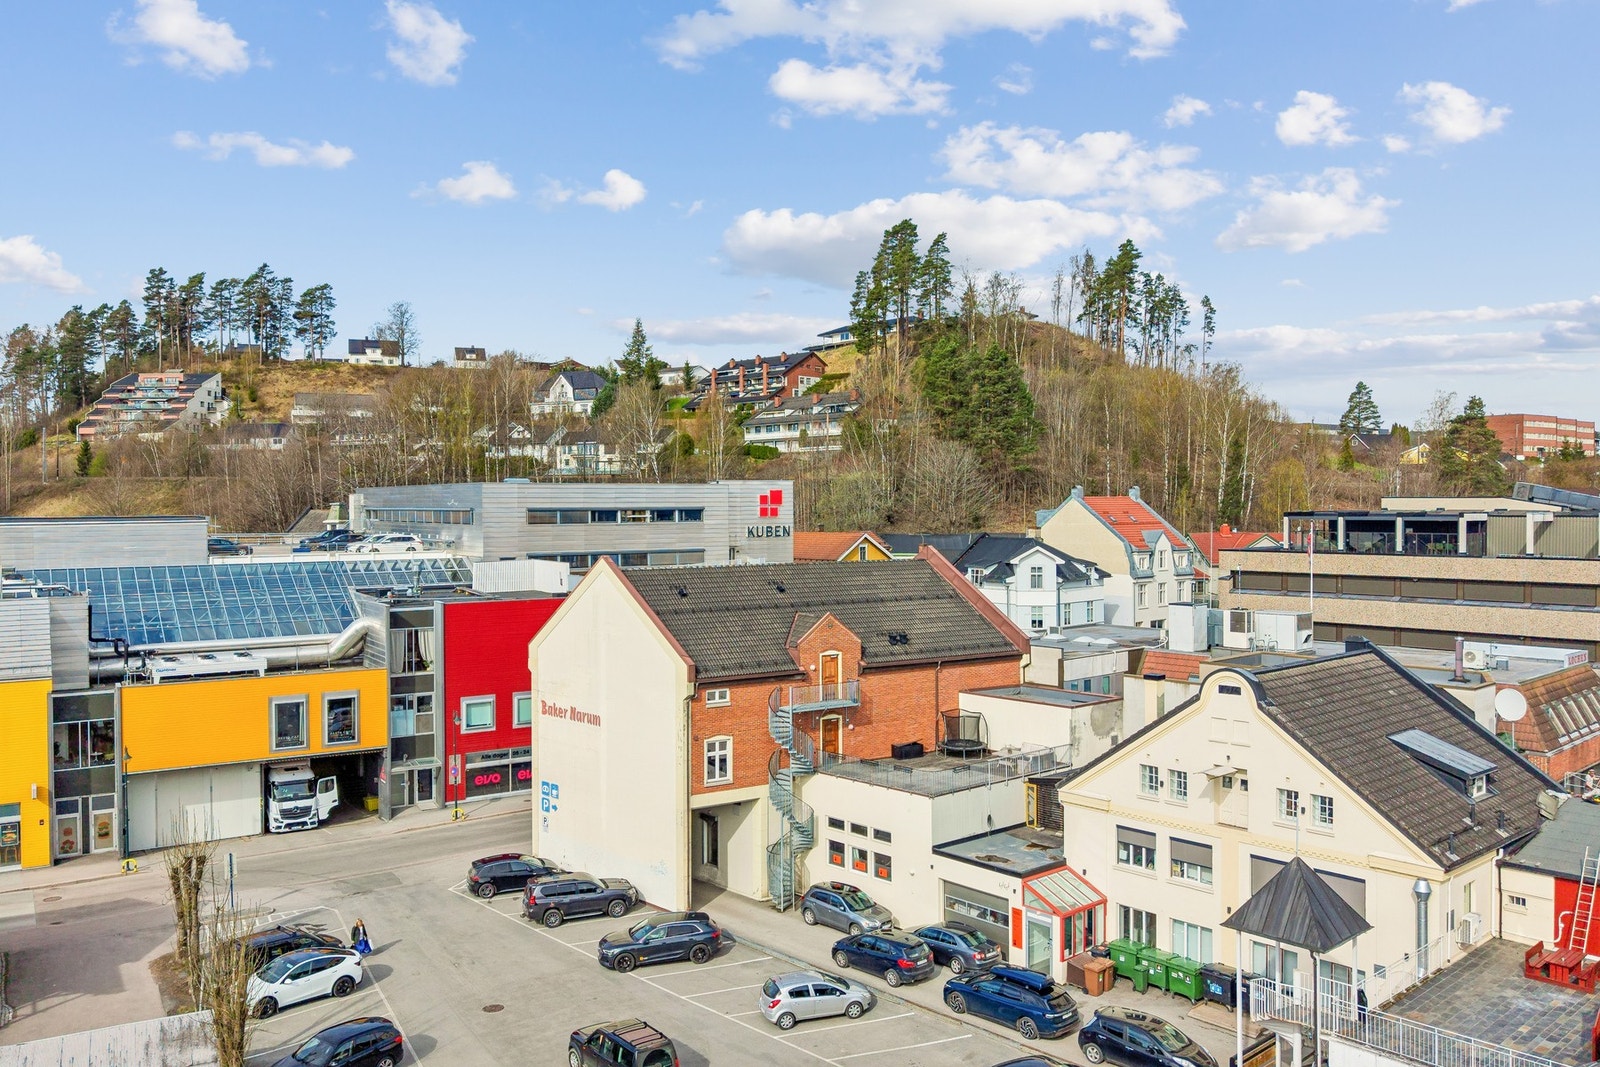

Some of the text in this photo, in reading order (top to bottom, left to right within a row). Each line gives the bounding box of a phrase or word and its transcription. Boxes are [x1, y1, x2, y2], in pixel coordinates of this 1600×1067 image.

[747, 525, 791, 538] KUBEN
[541, 700, 601, 727] Baker Narum
[475, 773, 501, 785] evo
